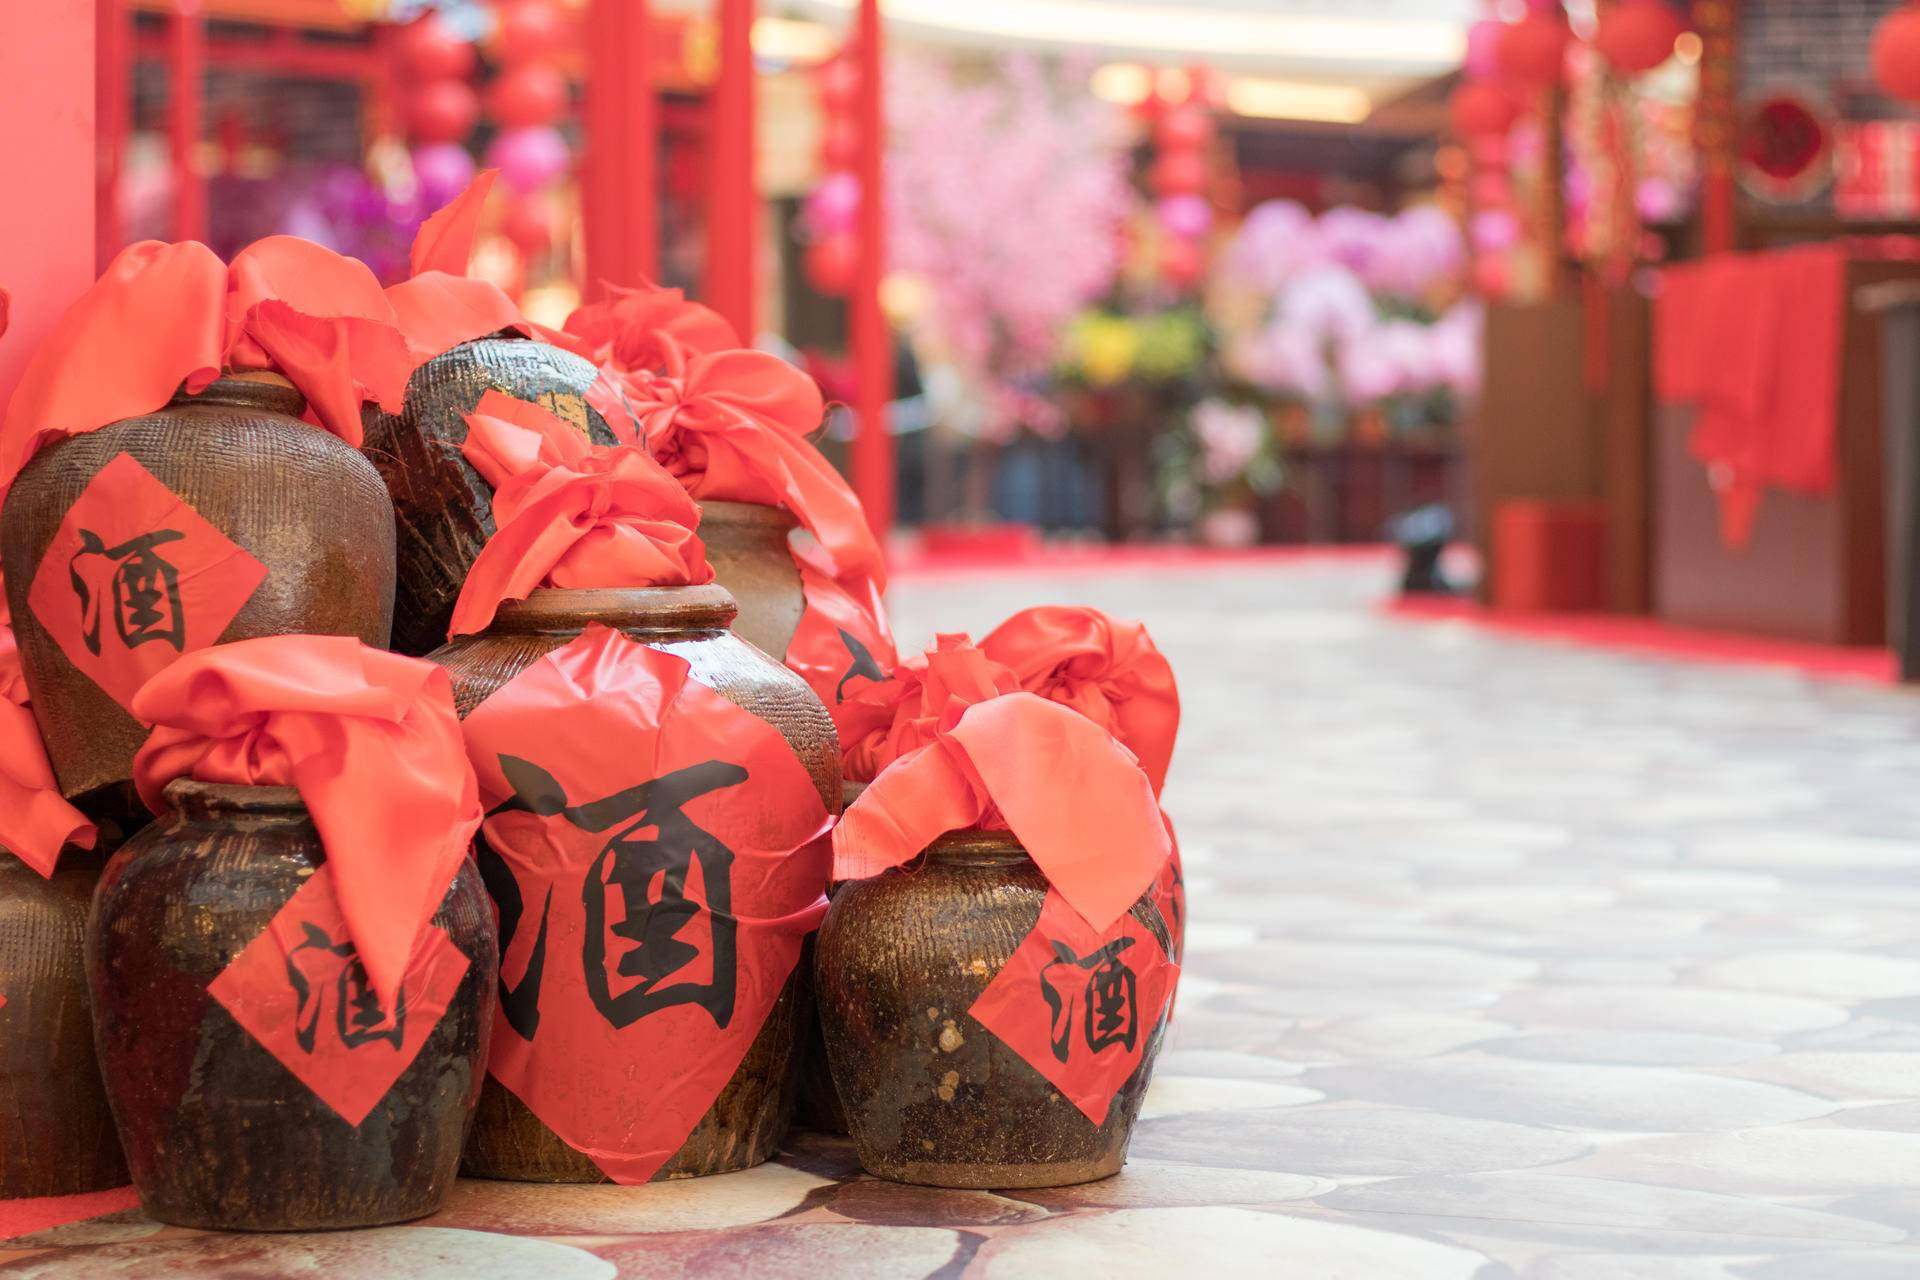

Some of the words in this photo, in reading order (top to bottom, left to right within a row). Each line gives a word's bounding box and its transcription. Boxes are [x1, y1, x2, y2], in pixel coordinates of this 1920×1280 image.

[70, 528, 185, 657] 酒
[477, 753, 749, 1041] 酒
[1040, 937, 1136, 1064] 酒
